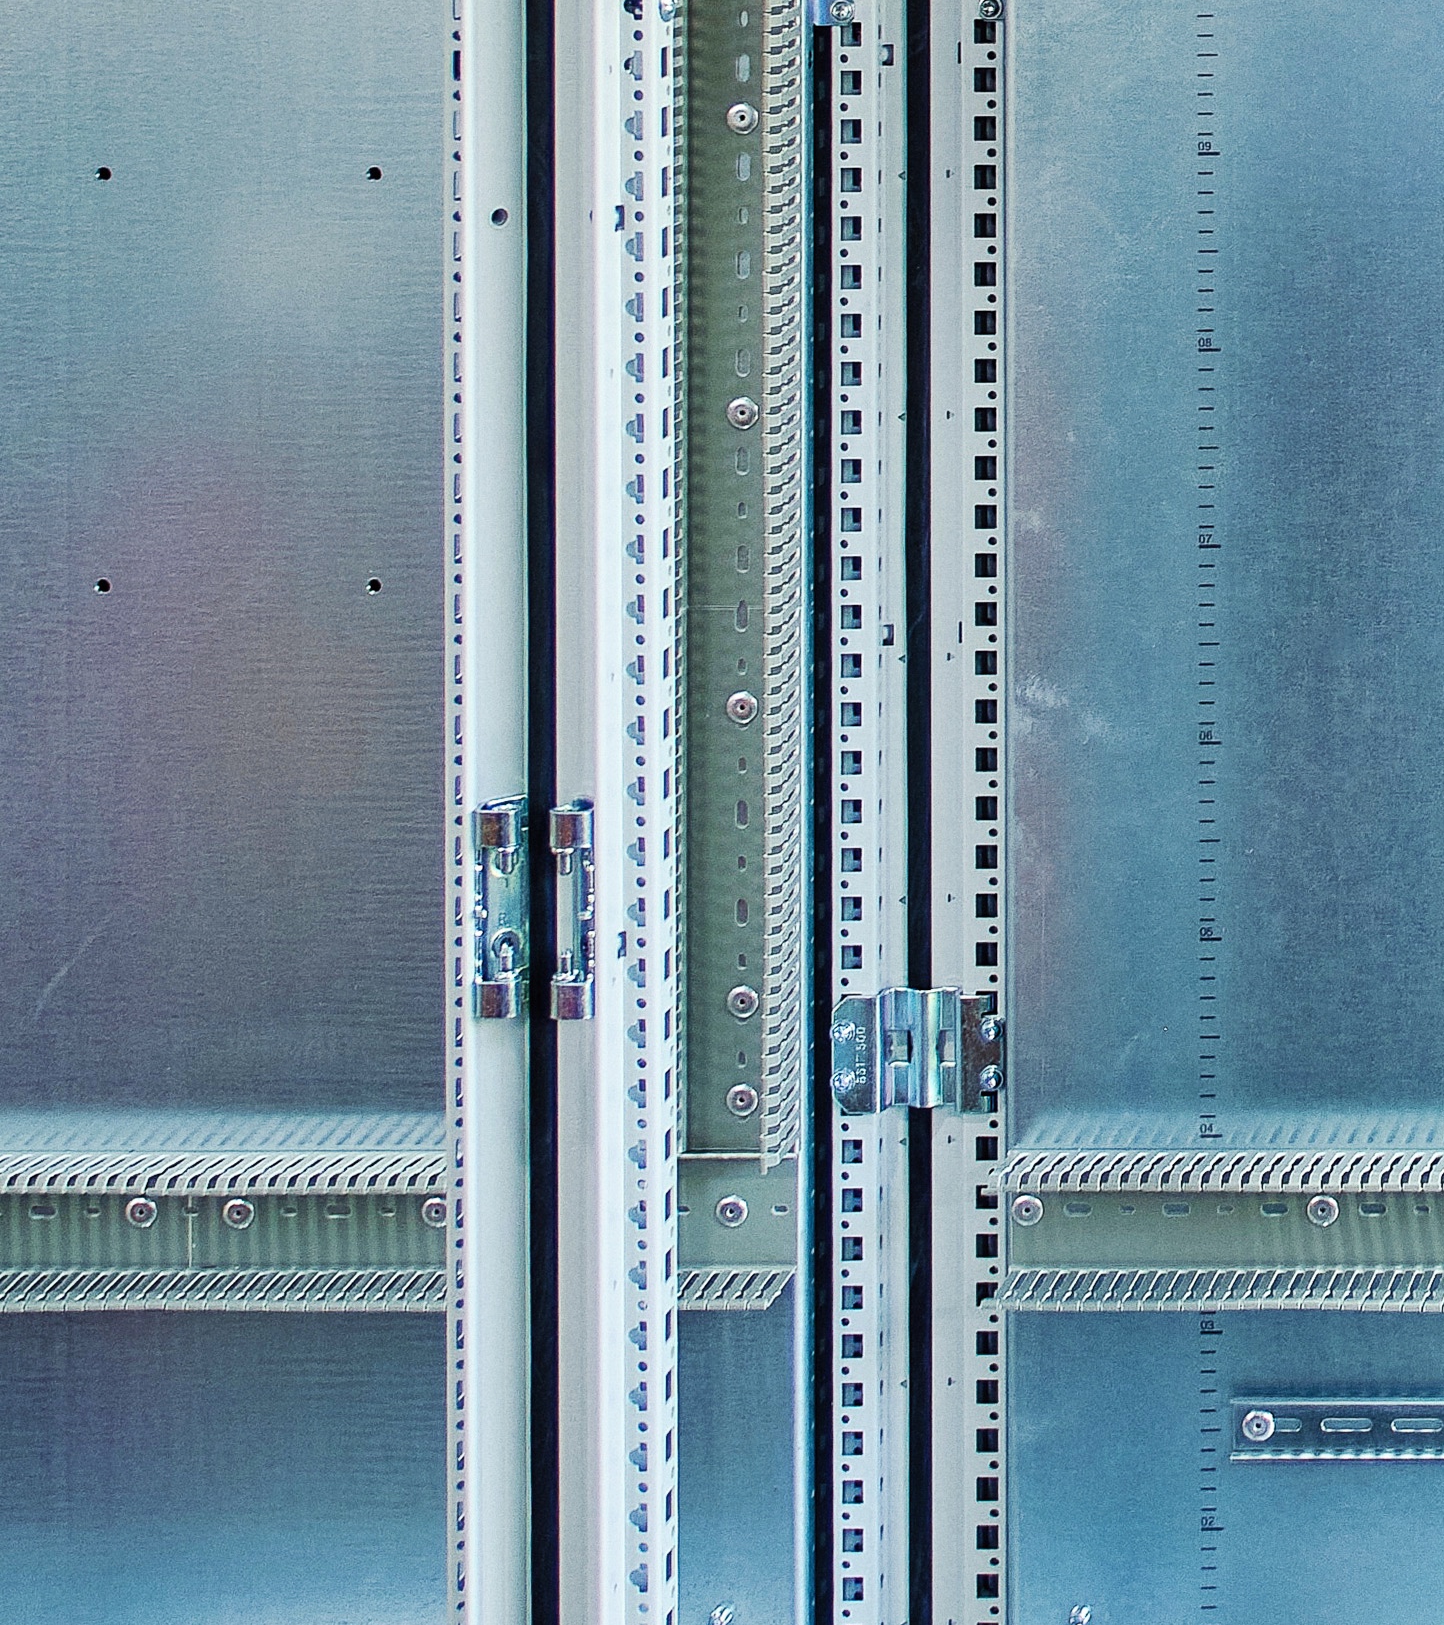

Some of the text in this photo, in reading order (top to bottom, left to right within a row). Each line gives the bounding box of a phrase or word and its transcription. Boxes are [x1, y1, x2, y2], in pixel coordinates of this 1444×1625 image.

[1198, 142, 1212, 153] 09
[1198, 338, 1212, 349] 08
[1198, 535, 1212, 546] 07
[1199, 731, 1213, 742] 06
[1199, 927, 1213, 938] 05
[1199, 1124, 1213, 1135] 04
[1199, 1320, 1213, 1331] 03
[1201, 1517, 1215, 1528] 02
